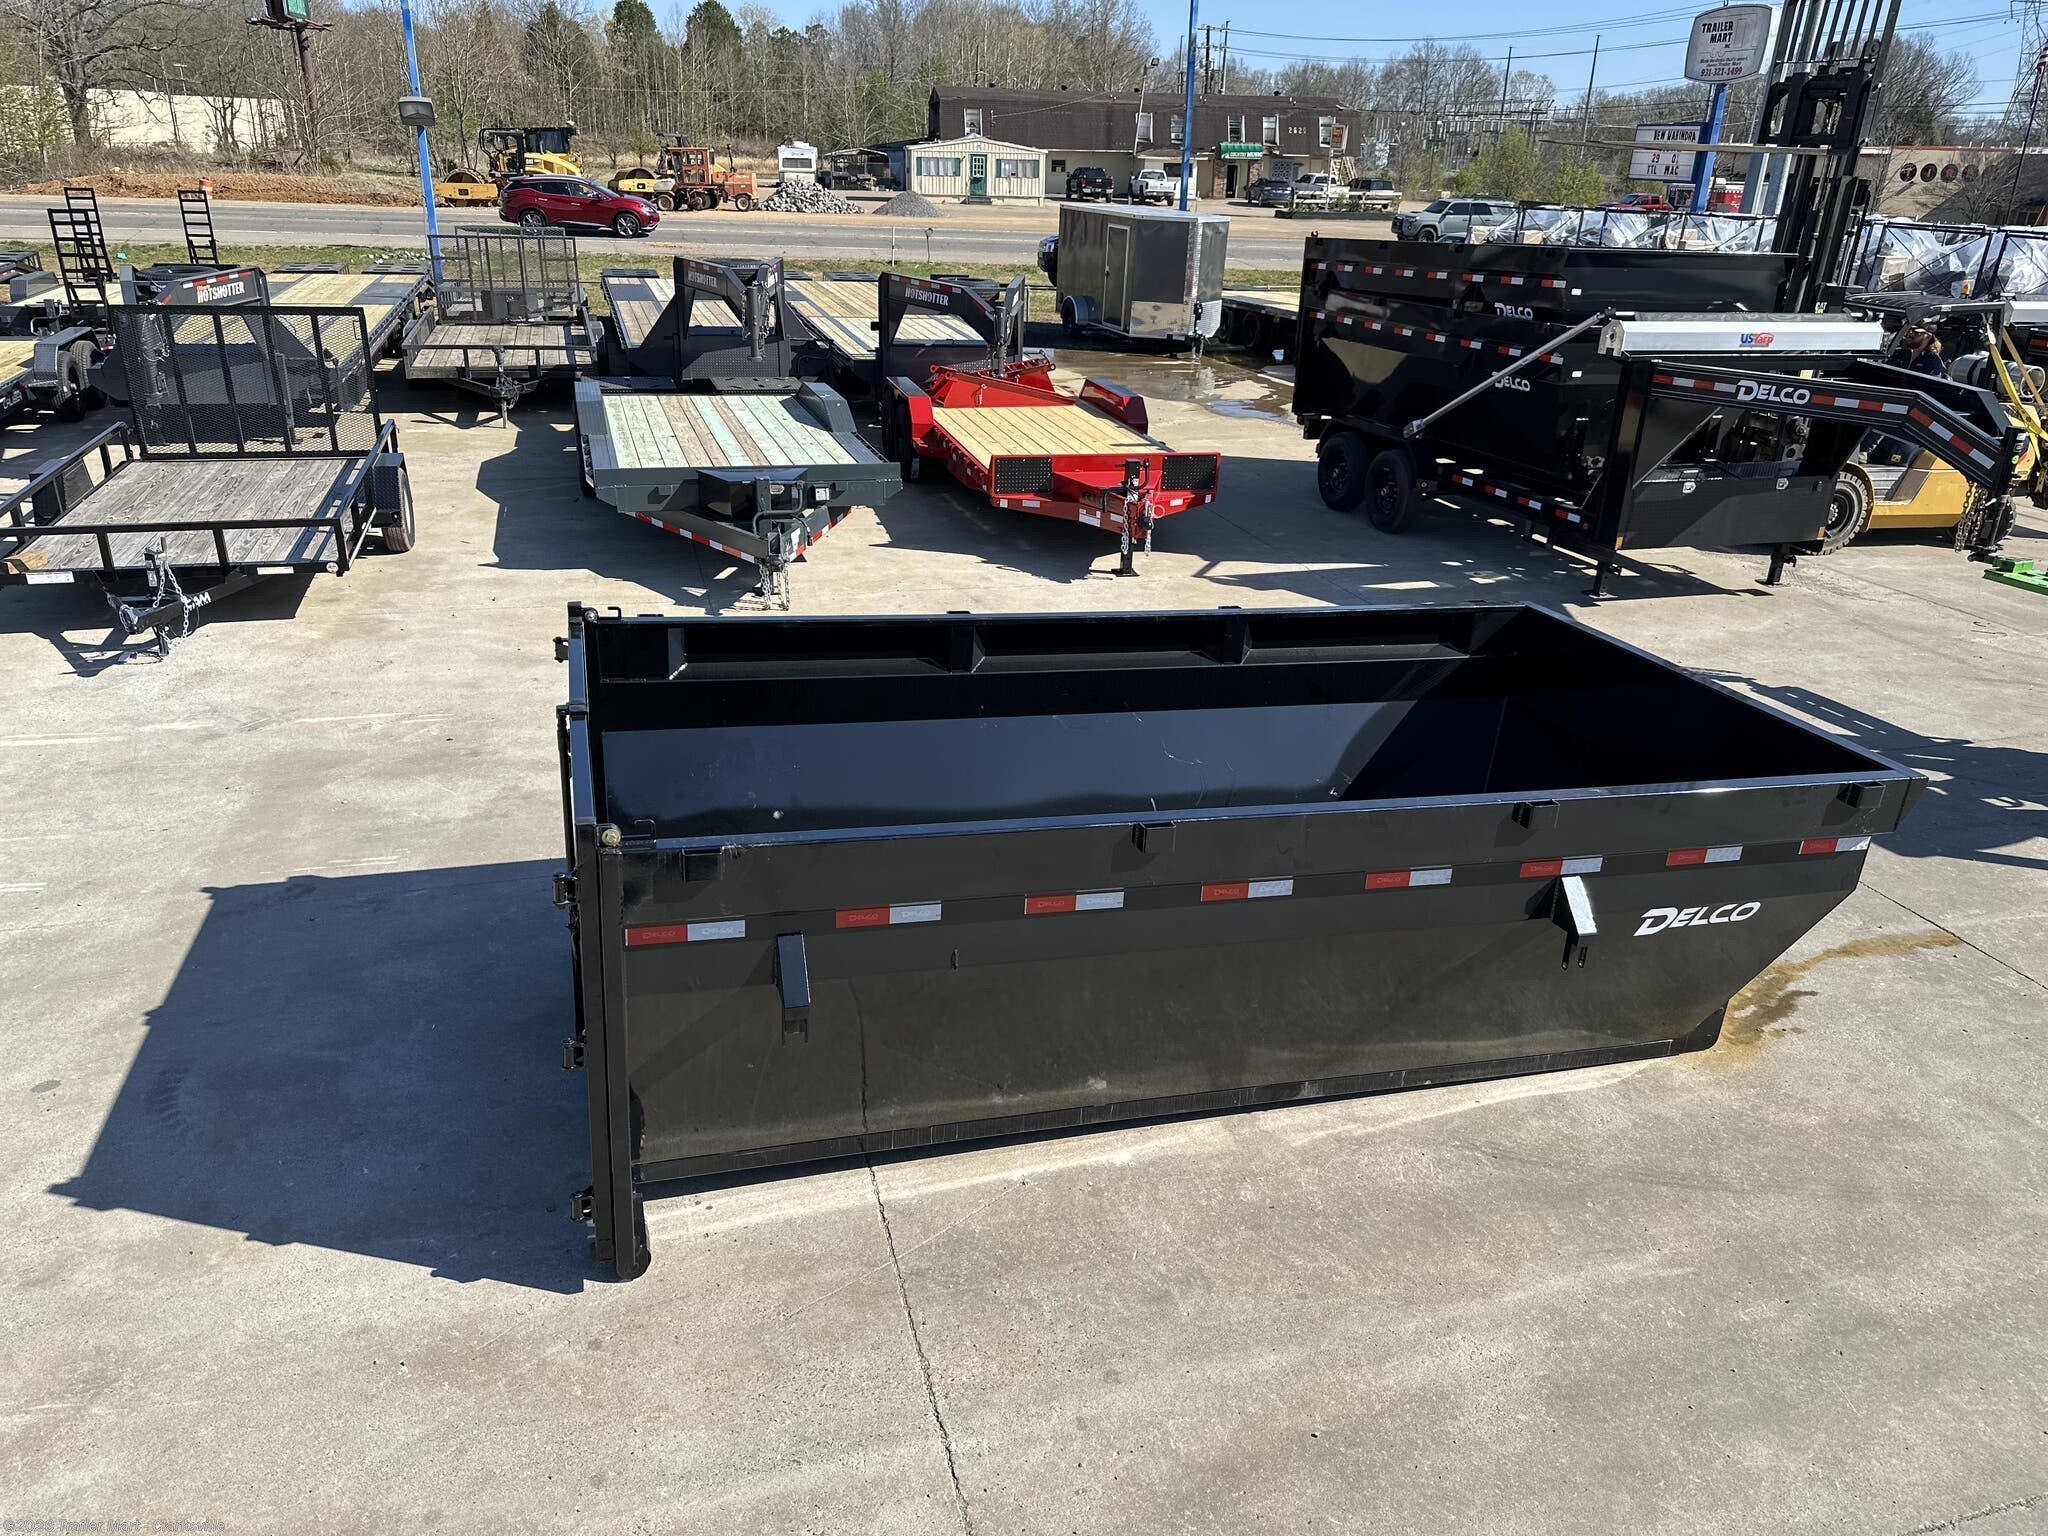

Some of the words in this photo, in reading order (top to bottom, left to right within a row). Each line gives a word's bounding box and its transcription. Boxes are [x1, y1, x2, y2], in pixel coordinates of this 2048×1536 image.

[1702, 21, 1733, 33] TRAILER
[1710, 32, 1732, 43] MART
[1700, 66, 1743, 77] 931-321-1499
[196, 281, 246, 304] HOTSHOTTER
[904, 286, 950, 307] HOTSHOTTER
[1494, 302, 1533, 320] DELCO
[1736, 379, 1812, 405] DELCO
[1632, 901, 1761, 937] DELCO
